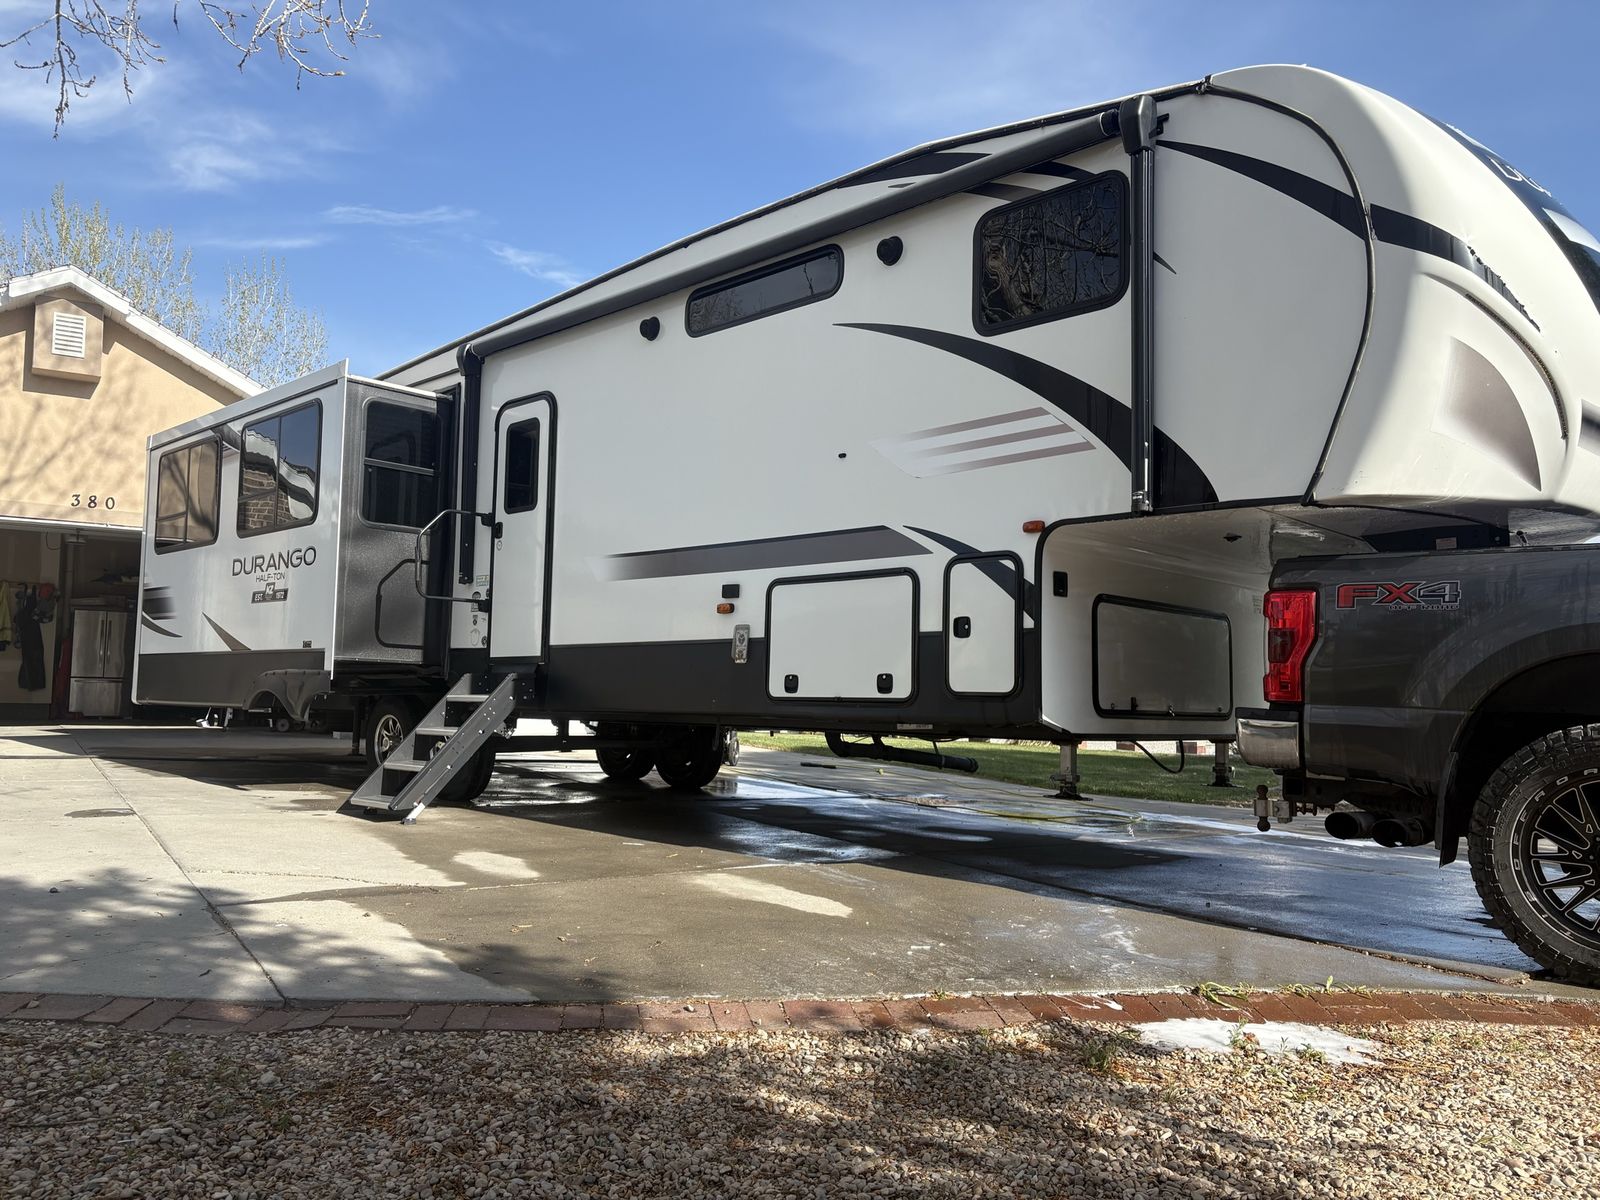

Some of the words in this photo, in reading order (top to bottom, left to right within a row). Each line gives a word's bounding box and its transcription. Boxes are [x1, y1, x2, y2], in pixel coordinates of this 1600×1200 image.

[70, 493, 116, 510] 380
[232, 546, 316, 576] DURANGO
[255, 571, 286, 583] HALF-TON
[1335, 580, 1462, 611] FX4
